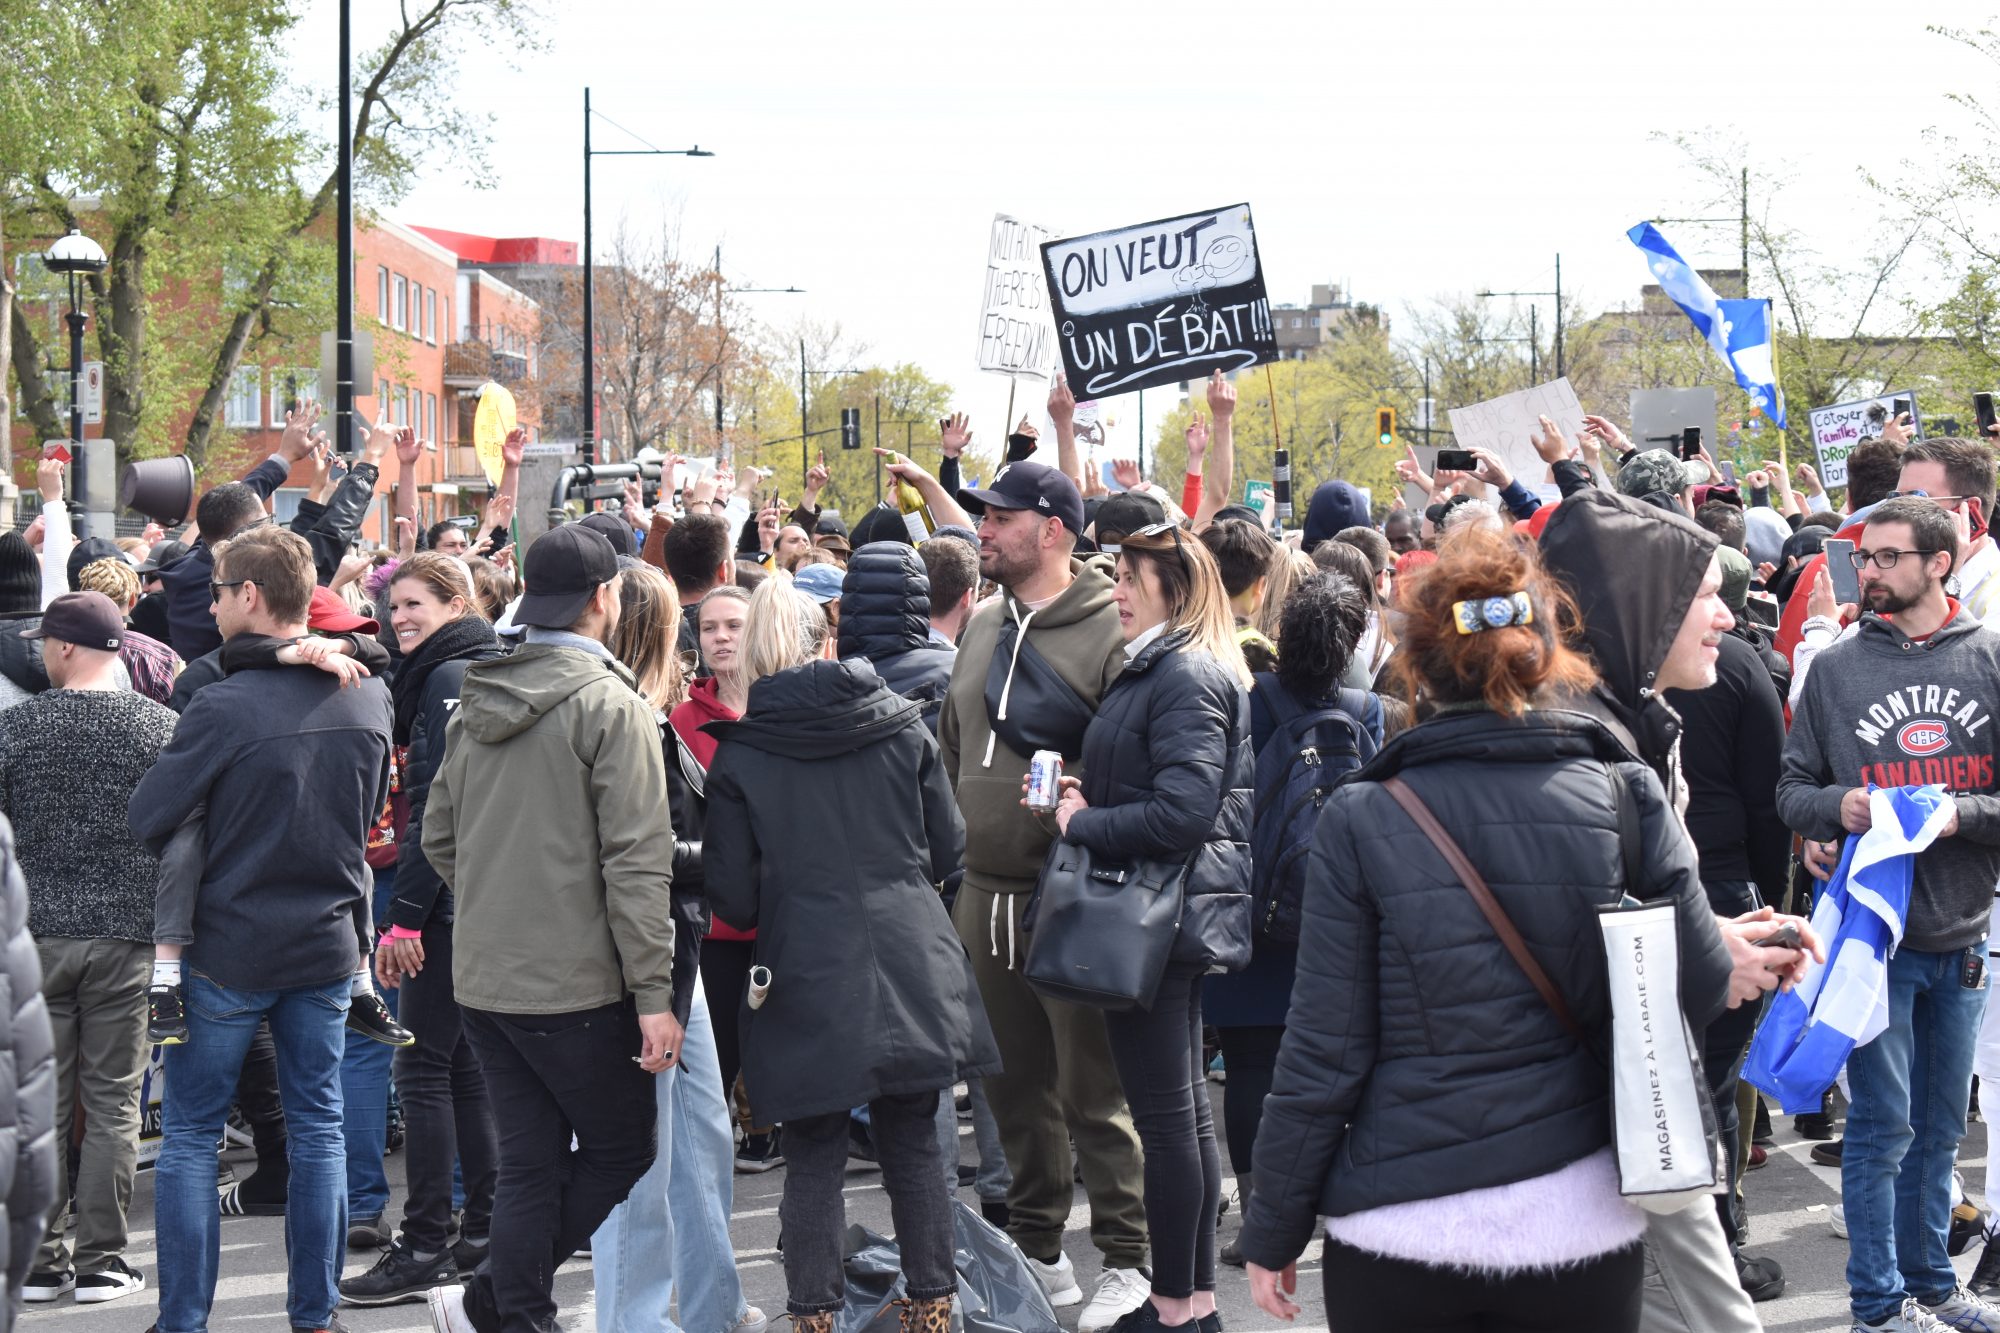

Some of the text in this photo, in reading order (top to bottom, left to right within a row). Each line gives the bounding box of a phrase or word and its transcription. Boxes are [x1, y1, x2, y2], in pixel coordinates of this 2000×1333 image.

[987, 264, 1029, 310] THERE
[1062, 247, 1108, 298] ON
[1115, 215, 1218, 283] VEUT
[1070, 297, 1273, 371] UN DÉBAT!!!
[1814, 410, 1863, 428] Côtoyer
[1855, 684, 1991, 747] MONTREAL
[1860, 754, 1994, 791] CANADIENS
[1634, 935, 1653, 1044] LABAIE.COM
[1649, 1067, 1674, 1171] MAGASINEZ
